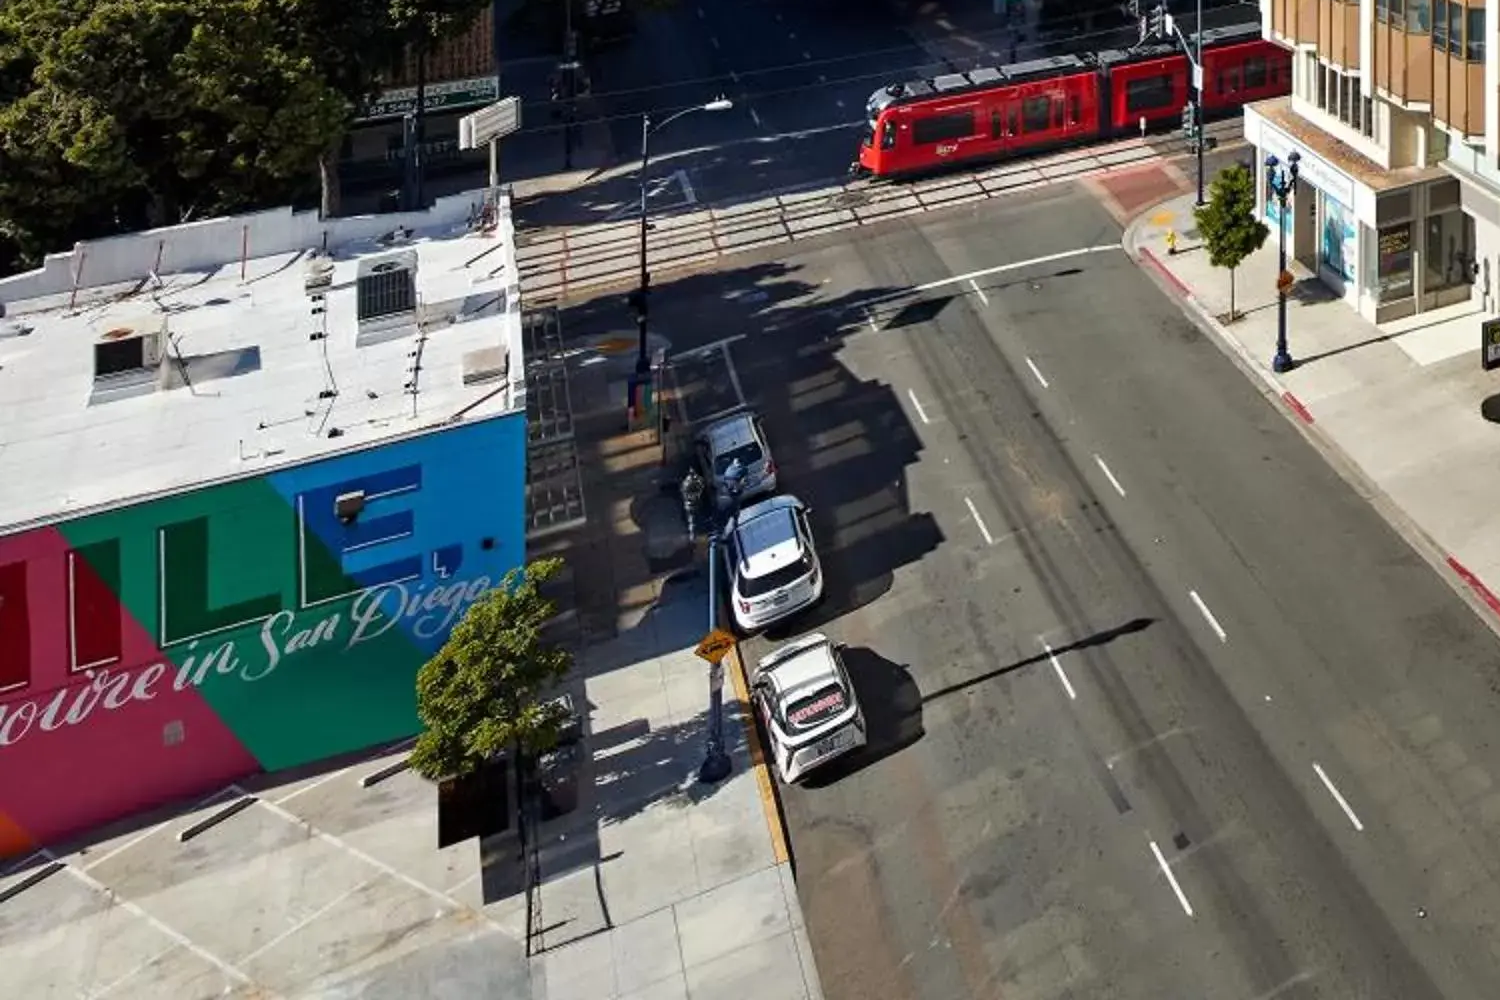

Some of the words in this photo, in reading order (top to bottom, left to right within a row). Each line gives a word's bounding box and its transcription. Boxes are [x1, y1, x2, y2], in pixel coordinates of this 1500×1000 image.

[0, 463, 464, 692] ILE,
[0, 663, 166, 746] ou're
[173, 640, 239, 691] in
[240, 609, 341, 682] San
[344, 576, 491, 652] Diego
